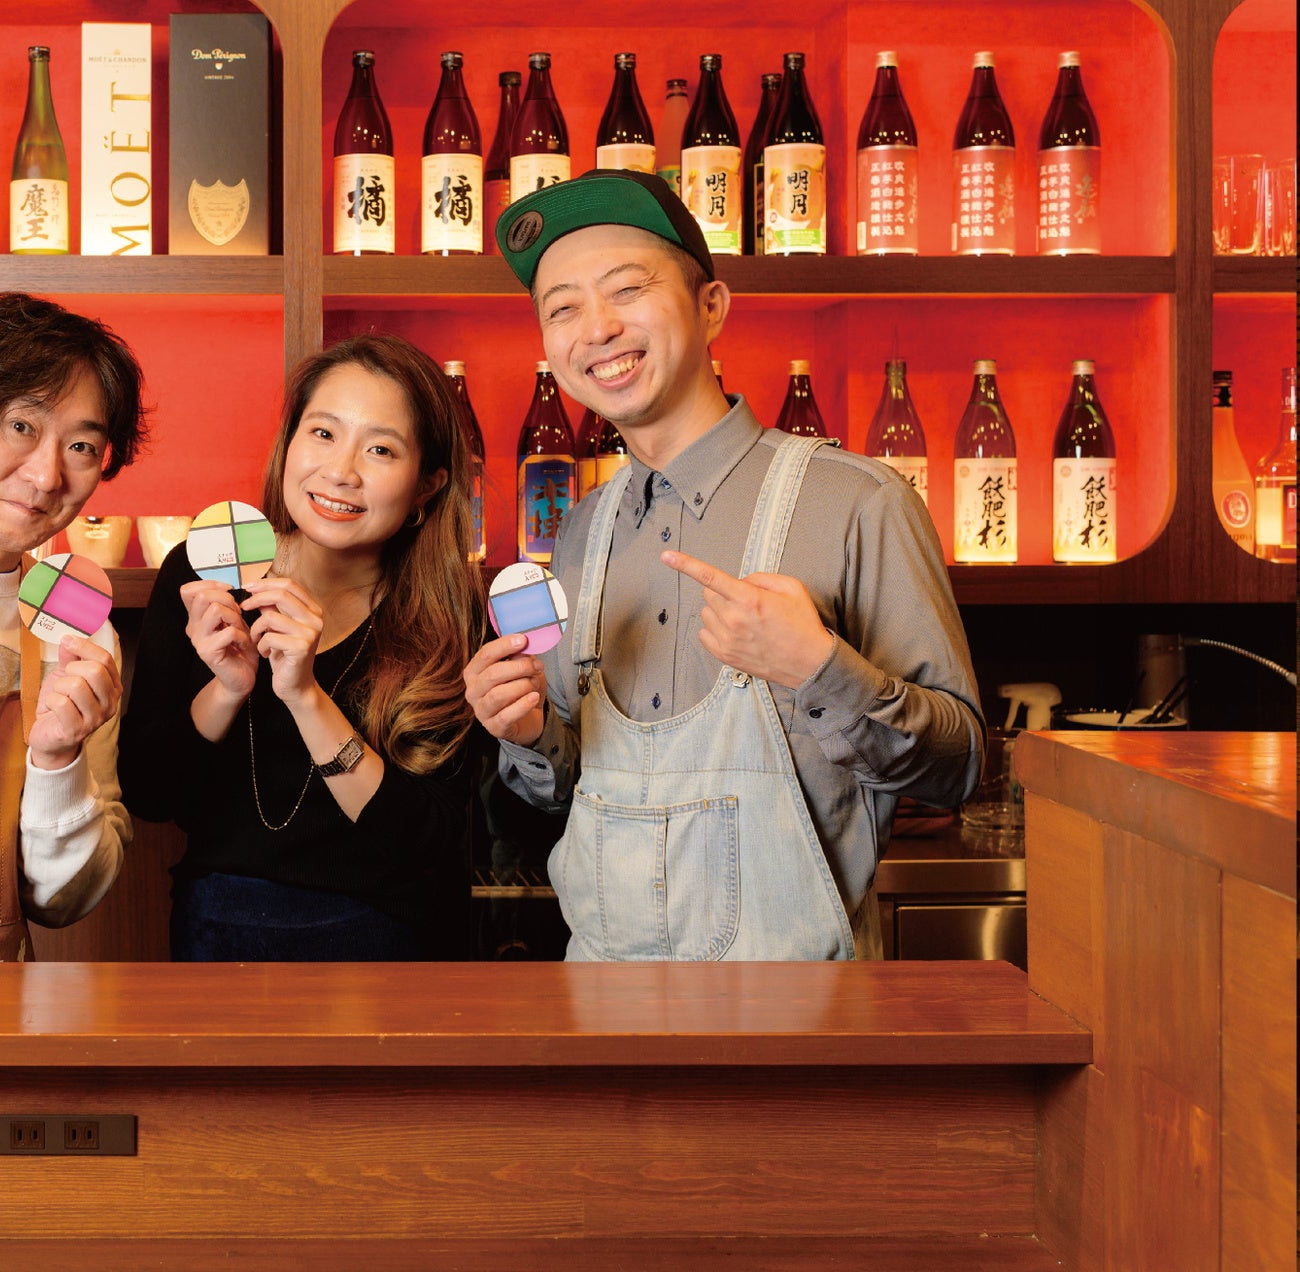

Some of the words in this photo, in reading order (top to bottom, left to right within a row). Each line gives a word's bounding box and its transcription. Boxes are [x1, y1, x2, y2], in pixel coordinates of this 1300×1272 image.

[191, 49, 211, 59] Dom
[103, 82, 150, 255] MOËT
[705, 171, 728, 218] 明月
[787, 170, 809, 217] 明月
[20, 184, 50, 241] 魔王
[347, 175, 386, 227] 橘
[434, 175, 473, 227] 橘
[976, 476, 1007, 549] 飫肥杉
[1079, 476, 1108, 549] 飫肥杉
